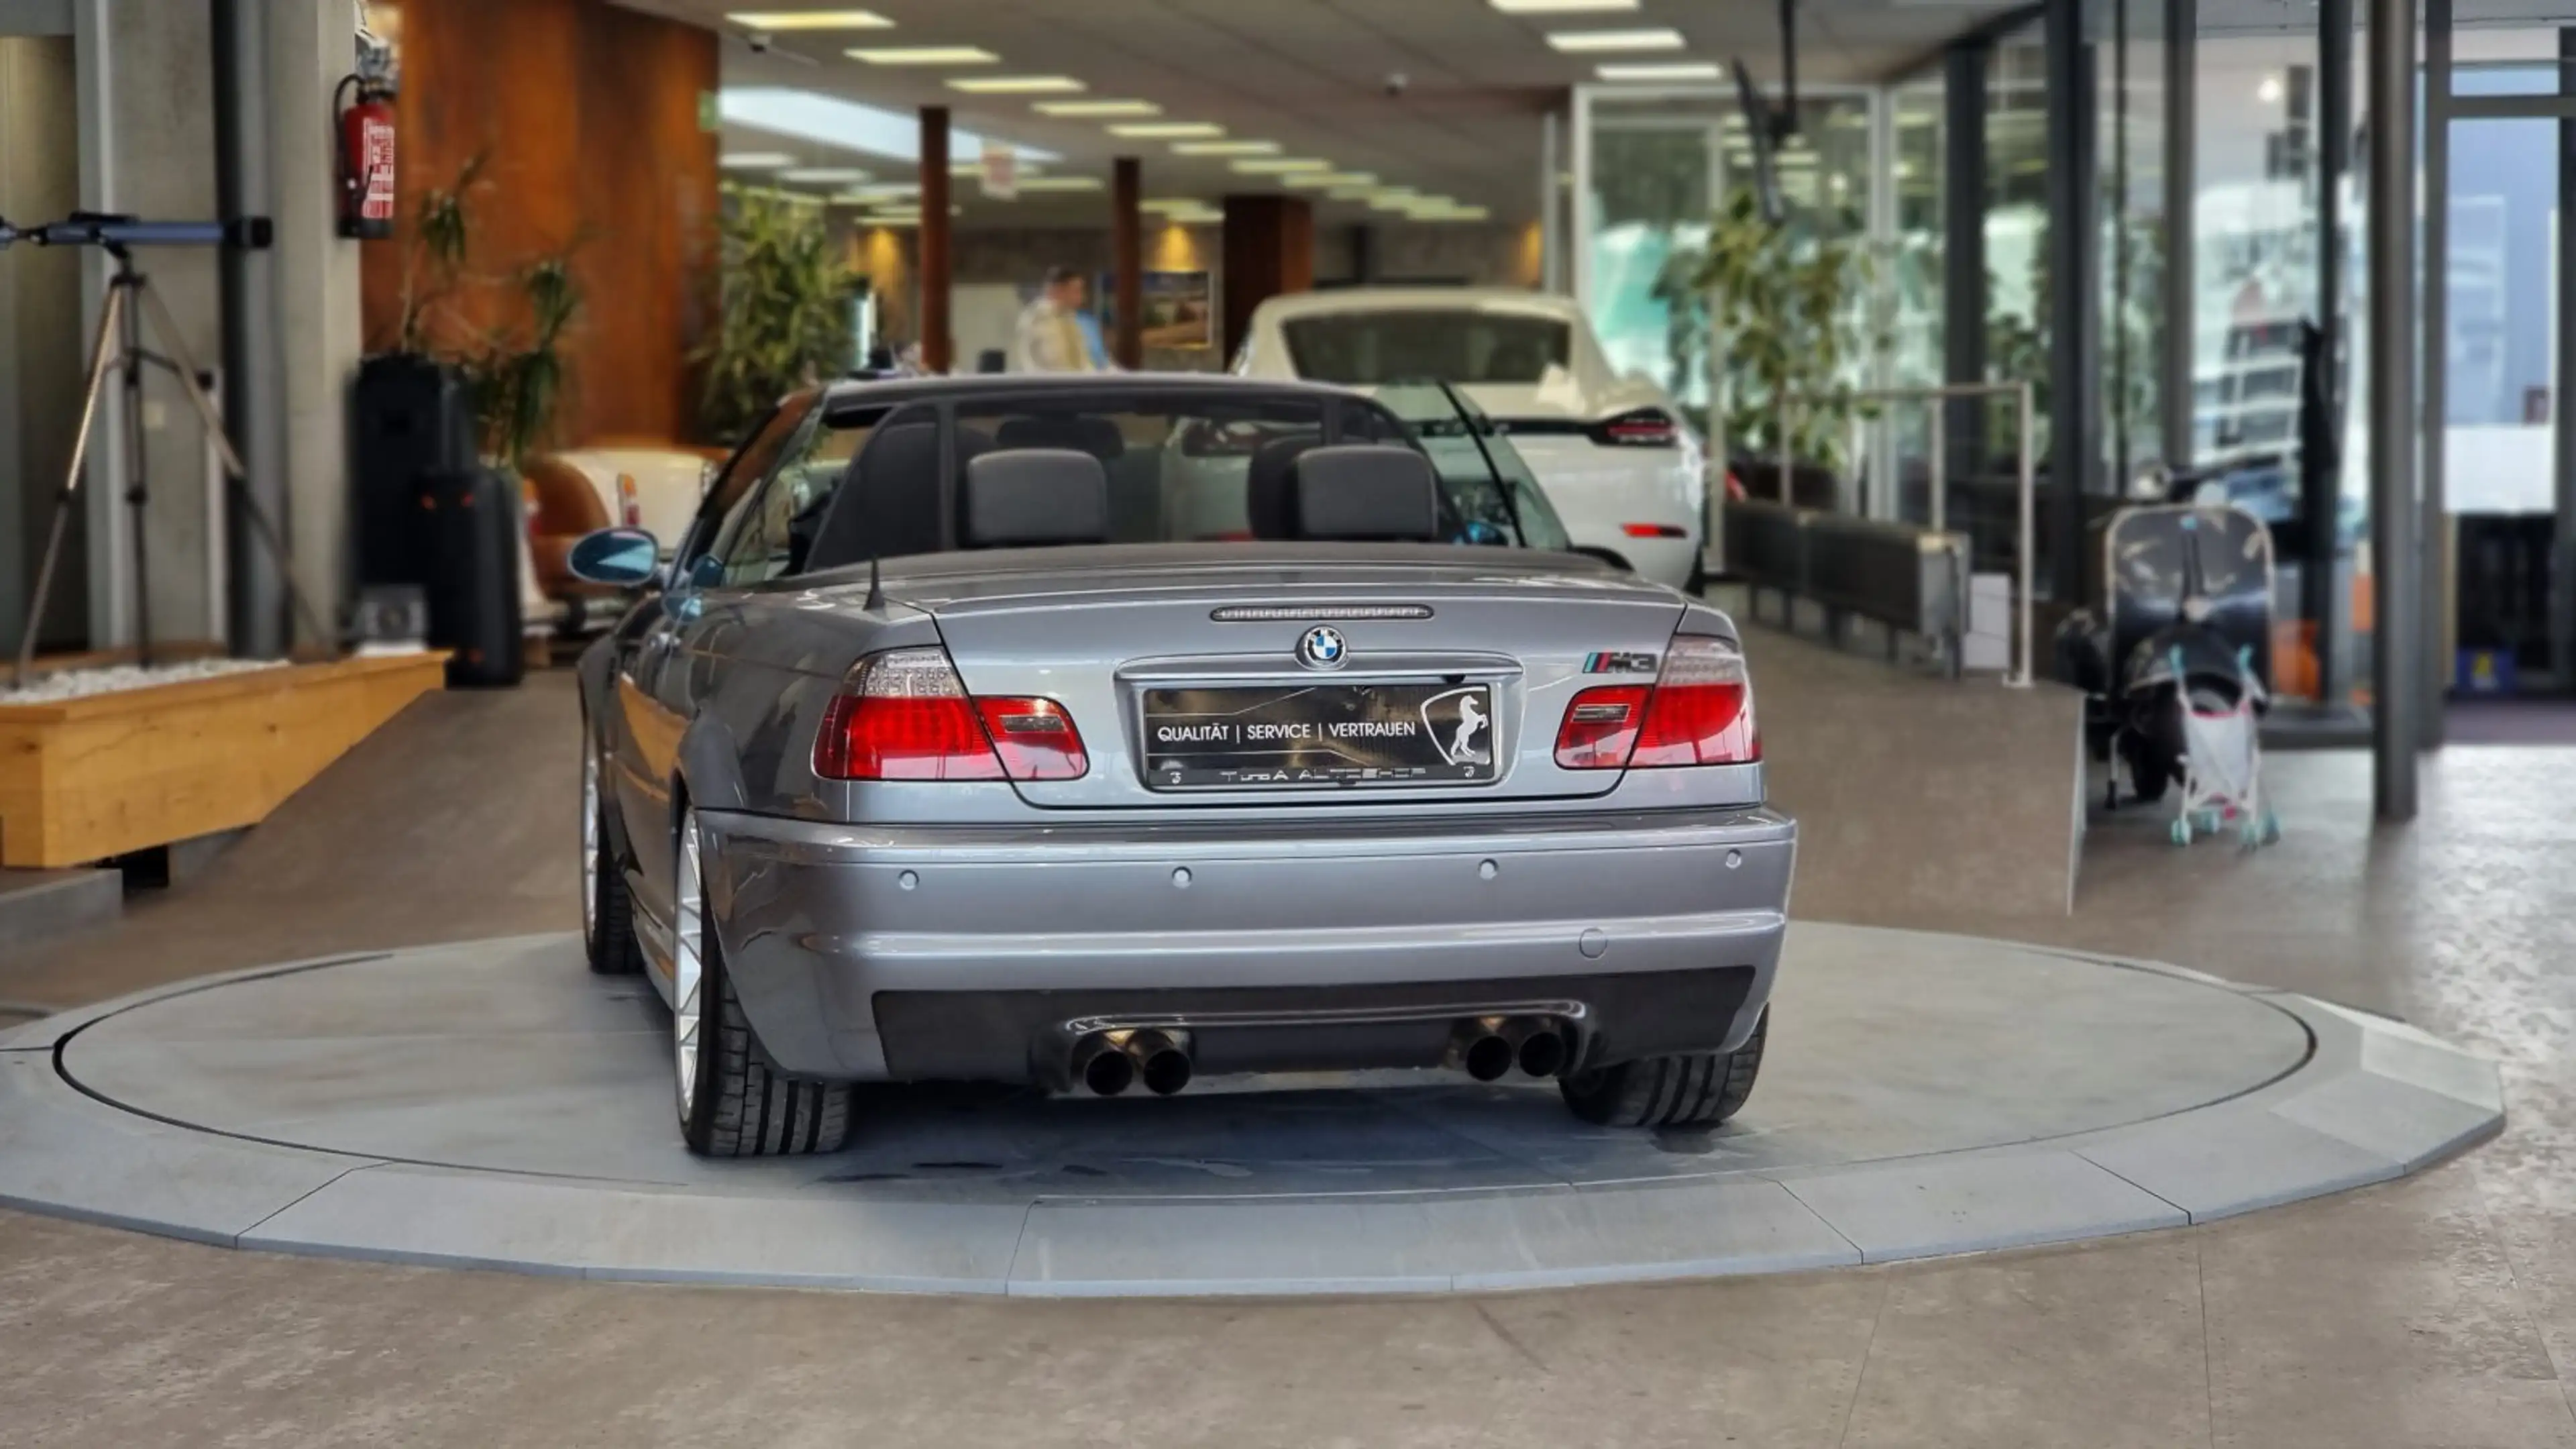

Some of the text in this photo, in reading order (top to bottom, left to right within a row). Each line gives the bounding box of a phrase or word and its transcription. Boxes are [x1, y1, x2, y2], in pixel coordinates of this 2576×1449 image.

[1608, 652, 1658, 674] M3
[1157, 721, 1416, 741] QUALITÄT SERVICE VERTRAUEN
